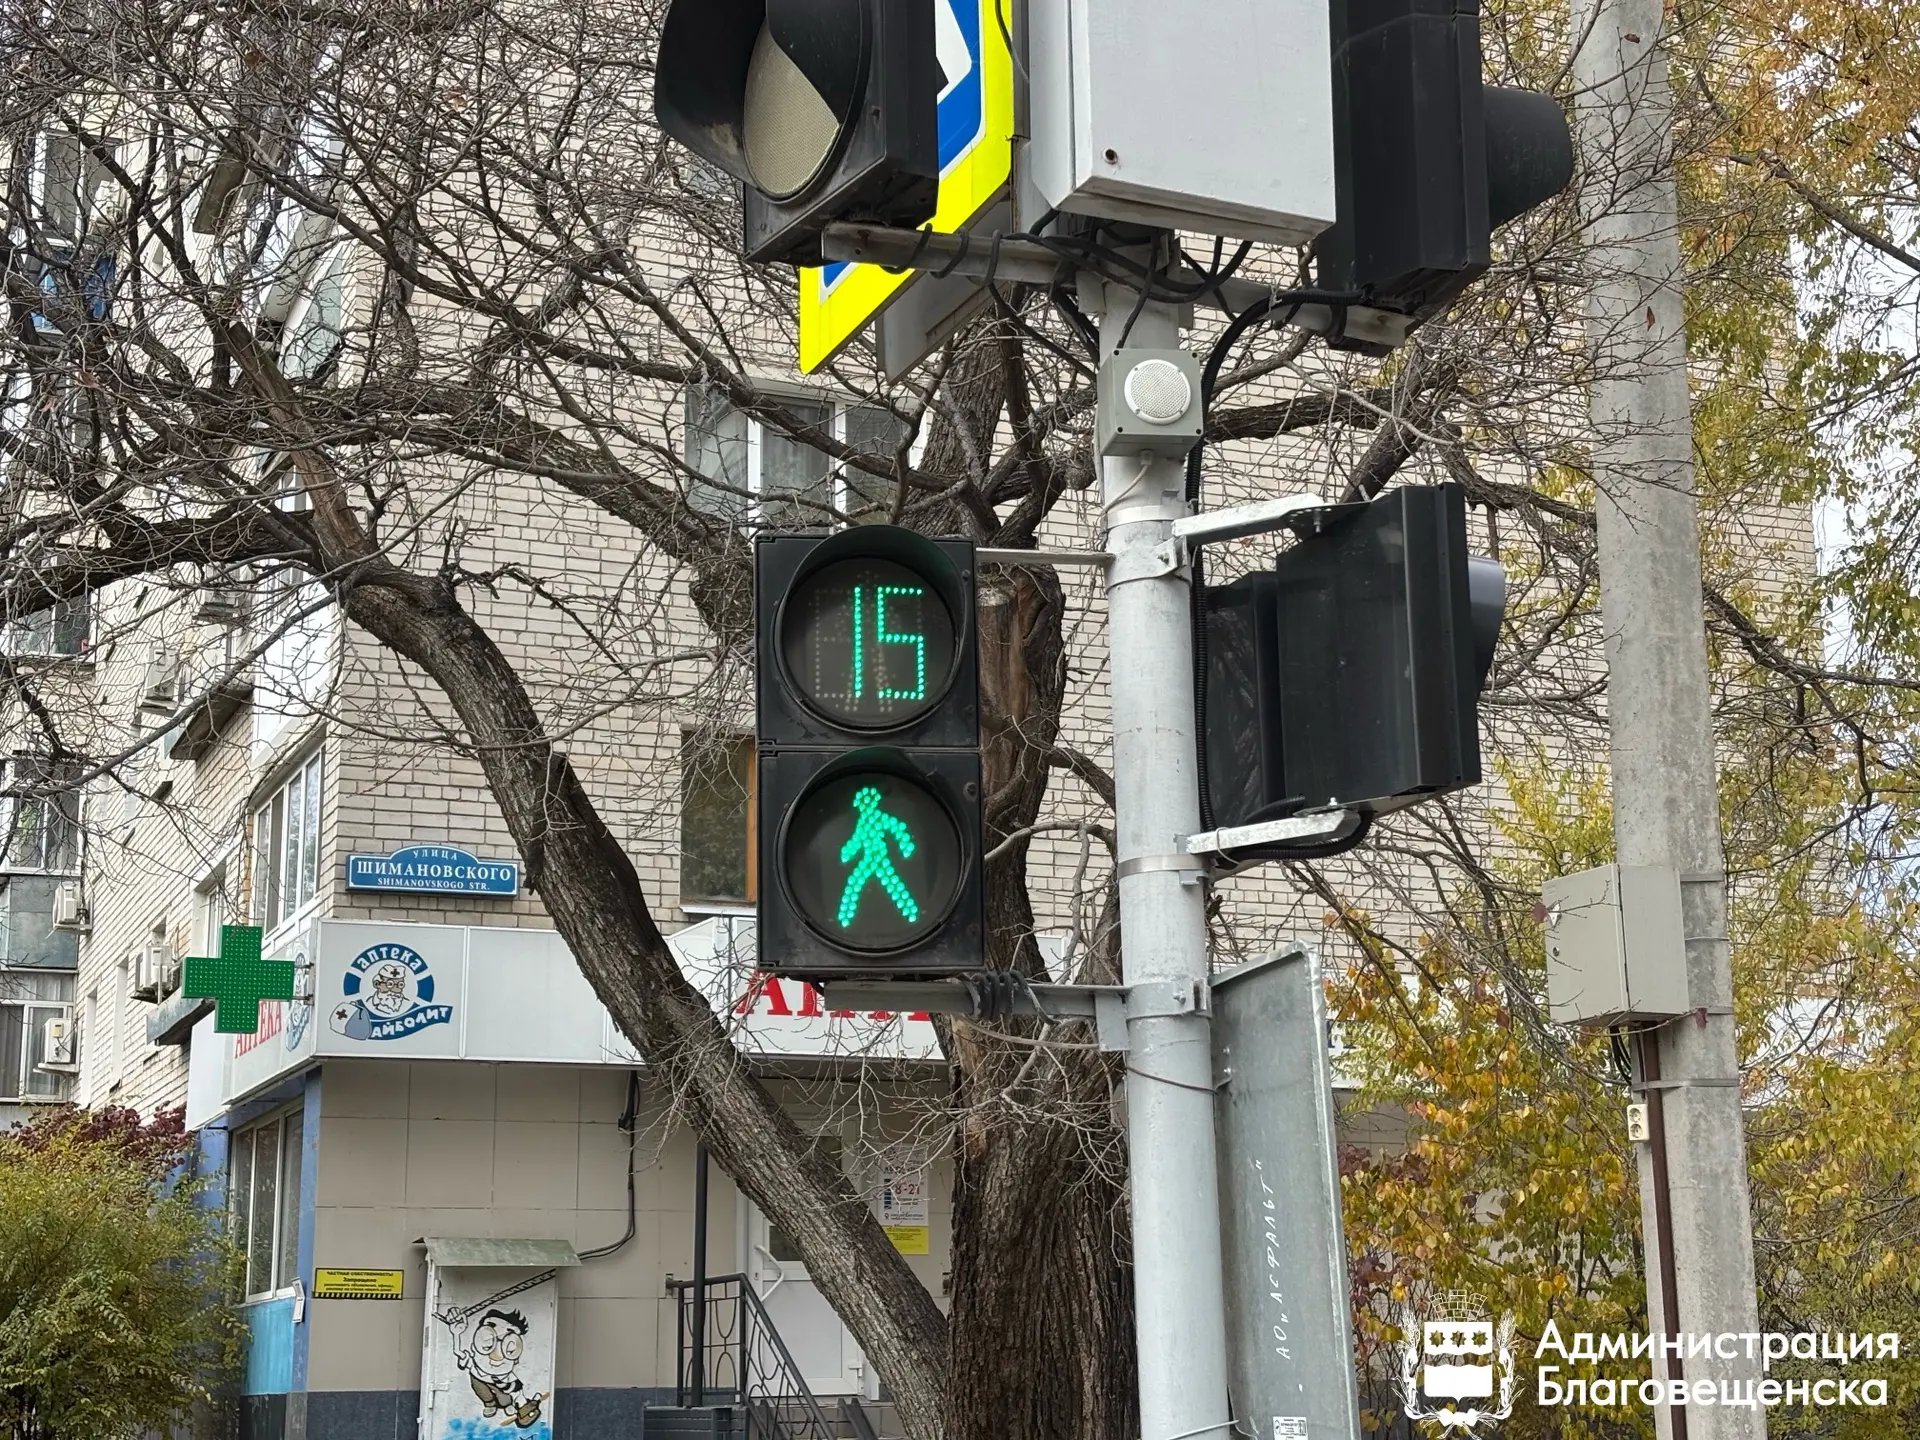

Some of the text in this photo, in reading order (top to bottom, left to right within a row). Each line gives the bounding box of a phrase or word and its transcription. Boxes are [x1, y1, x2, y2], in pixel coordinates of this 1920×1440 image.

[854, 585, 924, 700] 15
[412, 849, 458, 861] УЛИЦА
[356, 860, 511, 881] ШИМАНОВСКОГО
[377, 877, 490, 891] SHIMANOVSKOGO STR.
[370, 1007, 449, 1038] АЙБОЛИТ
